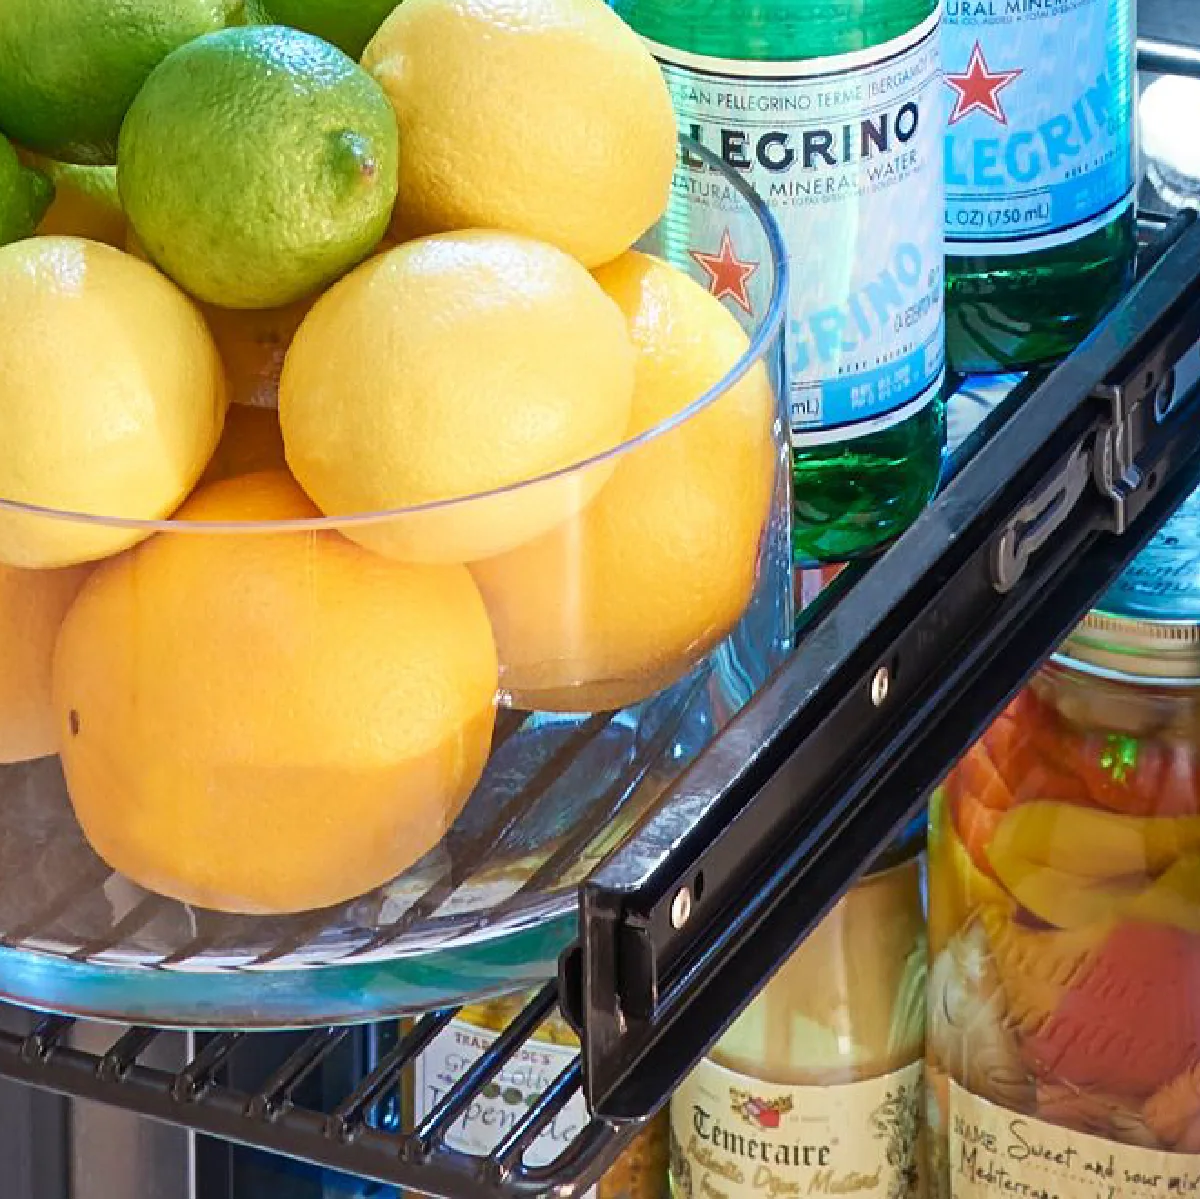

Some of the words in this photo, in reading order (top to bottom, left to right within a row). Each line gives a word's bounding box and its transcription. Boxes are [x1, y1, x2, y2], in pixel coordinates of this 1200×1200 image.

[717, 92, 811, 112] PELLEGRINO
[816, 86, 863, 108] TERME
[866, 148, 918, 182] WATER
[987, 208, 1020, 228] (750
